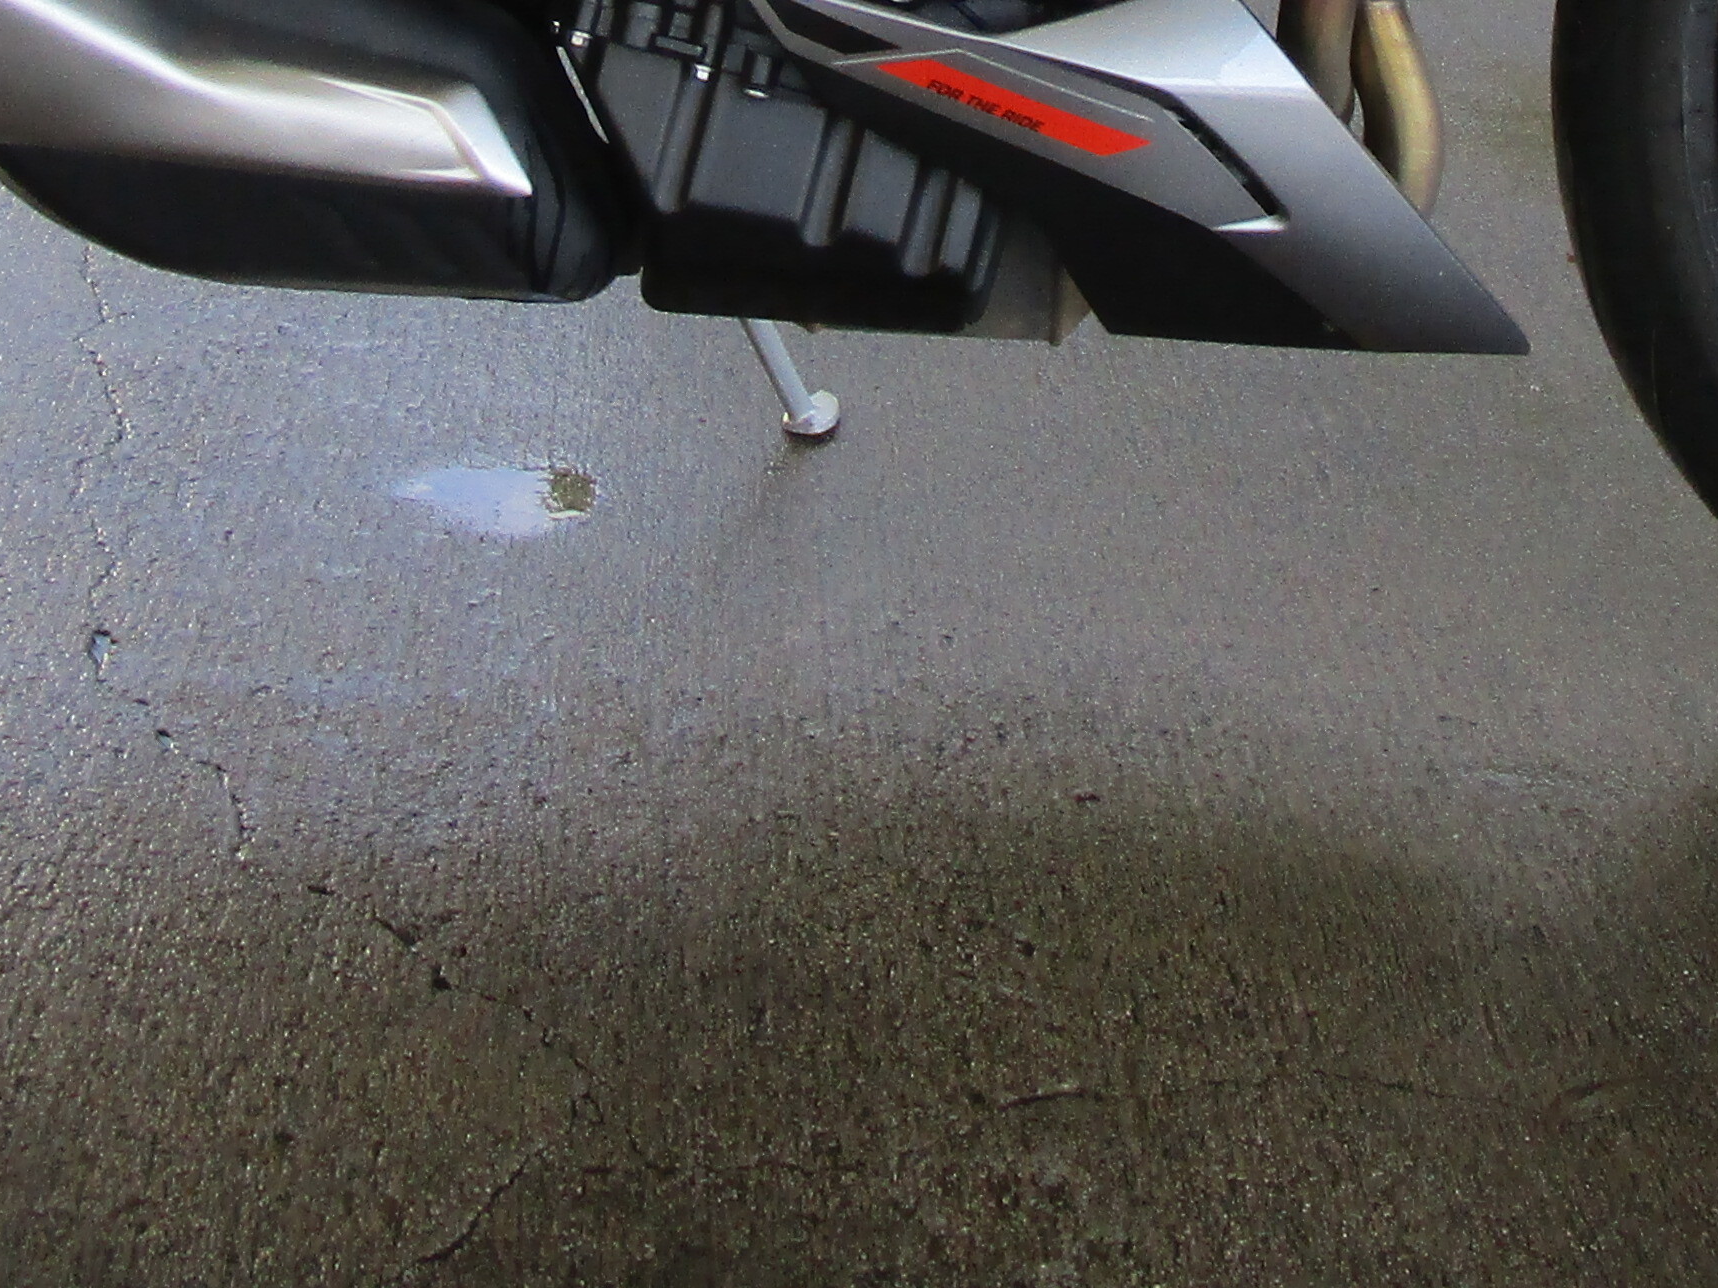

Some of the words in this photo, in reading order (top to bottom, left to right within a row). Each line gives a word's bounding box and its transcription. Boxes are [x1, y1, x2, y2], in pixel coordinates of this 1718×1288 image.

[926, 79, 964, 100] FOR
[966, 95, 1000, 116] THE
[1001, 109, 1045, 132] RIDE
